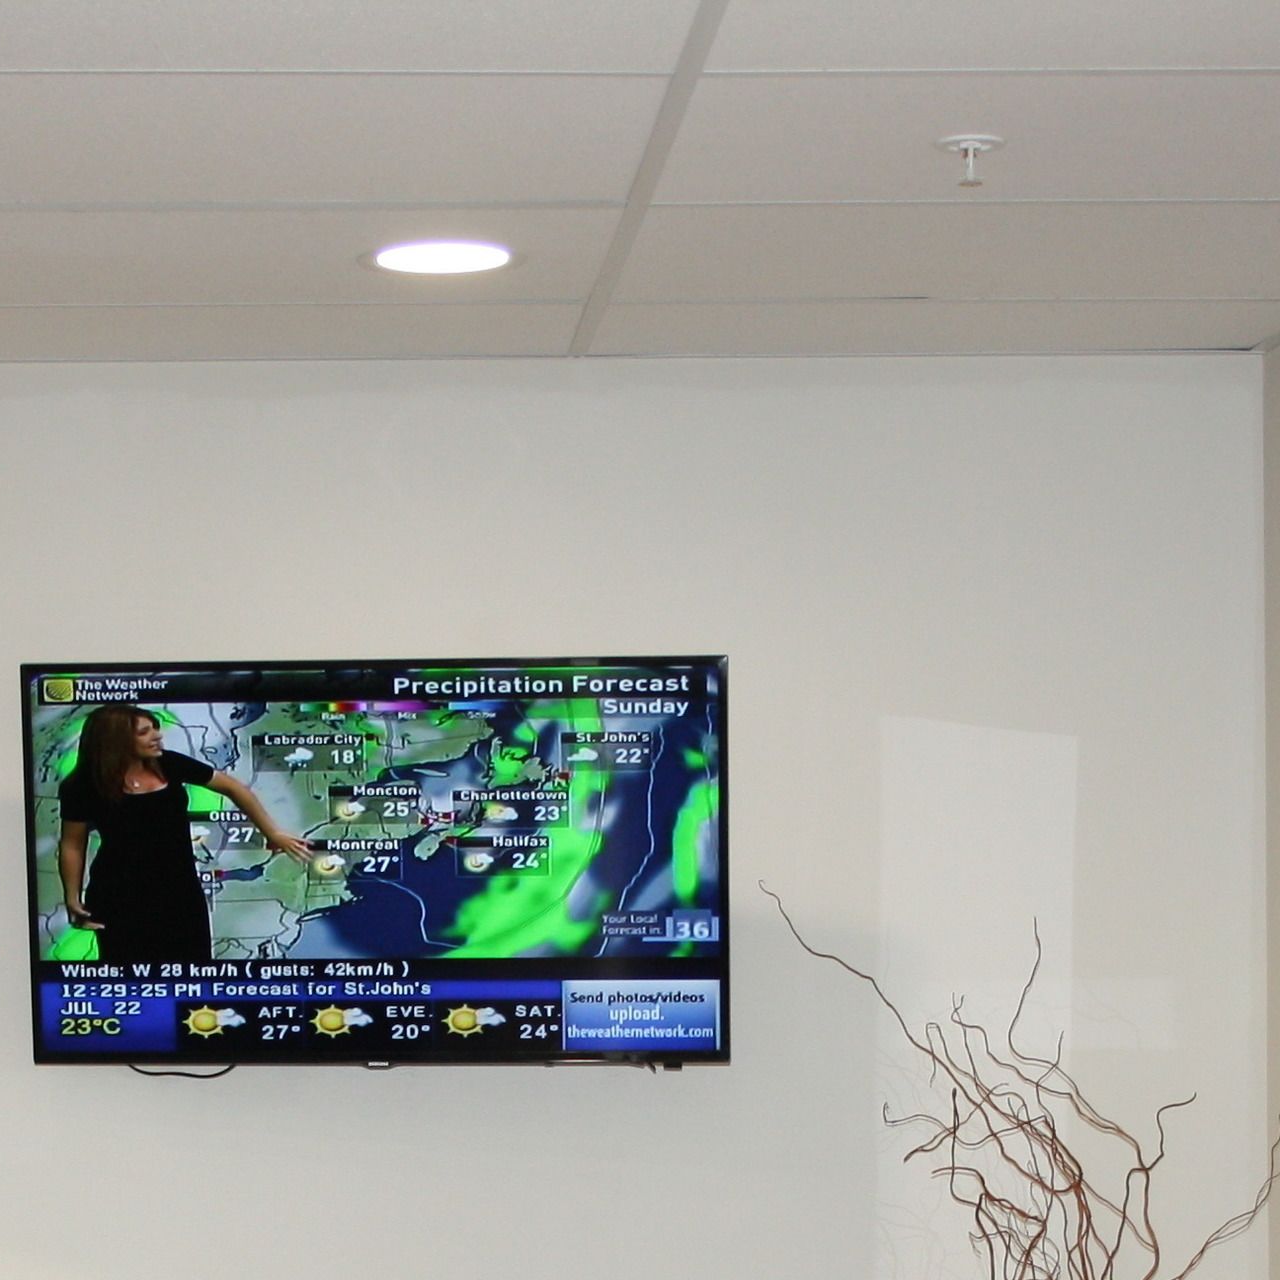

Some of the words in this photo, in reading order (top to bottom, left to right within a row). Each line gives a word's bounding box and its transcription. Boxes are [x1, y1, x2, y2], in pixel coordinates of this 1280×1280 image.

[75, 679, 102, 690] The
[106, 678, 168, 690] Weather
[394, 676, 564, 697] Precipitation
[573, 674, 689, 693] Forecast
[75, 690, 139, 701] Network
[603, 699, 689, 716] Sunday
[264, 734, 330, 746] Labrador
[333, 734, 362, 747] City
[576, 732, 596, 743] St.
[601, 731, 650, 743] John's
[615, 748, 650, 764] 22°
[353, 785, 419, 797] Moncton
[460, 788, 568, 801] Charlottetown
[493, 835, 548, 848] Halifax
[363, 856, 399, 873] 27°
[602, 914, 626, 924] Your
[630, 914, 658, 923] Local
[602, 926, 647, 935] Forecast
[676, 922, 710, 939] 36
[61, 963, 124, 978] Winds:
[132, 963, 151, 977] W
[160, 963, 183, 977] 28
[190, 962, 238, 977] km/h
[260, 962, 315, 980] gusts:
[324, 961, 394, 977] 42km/h
[62, 983, 167, 998] 12:29:25
[174, 983, 201, 997] PM
[213, 982, 299, 996] Forecast
[307, 981, 336, 996] for
[570, 991, 603, 1004] Send
[607, 990, 705, 1006] photos/videos
[61, 1001, 100, 1015] JUL
[114, 1001, 141, 1015] 22
[259, 1005, 304, 1018] AFT.
[386, 1005, 433, 1018] EVE.
[515, 1004, 561, 1017] SAT.
[609, 1004, 665, 1024] upload.
[61, 1018, 121, 1035] 23°C
[262, 1025, 301, 1040] 27°
[391, 1024, 431, 1040] 20°
[519, 1024, 558, 1039] 24°
[567, 1024, 714, 1039] theweathernetwork.com
